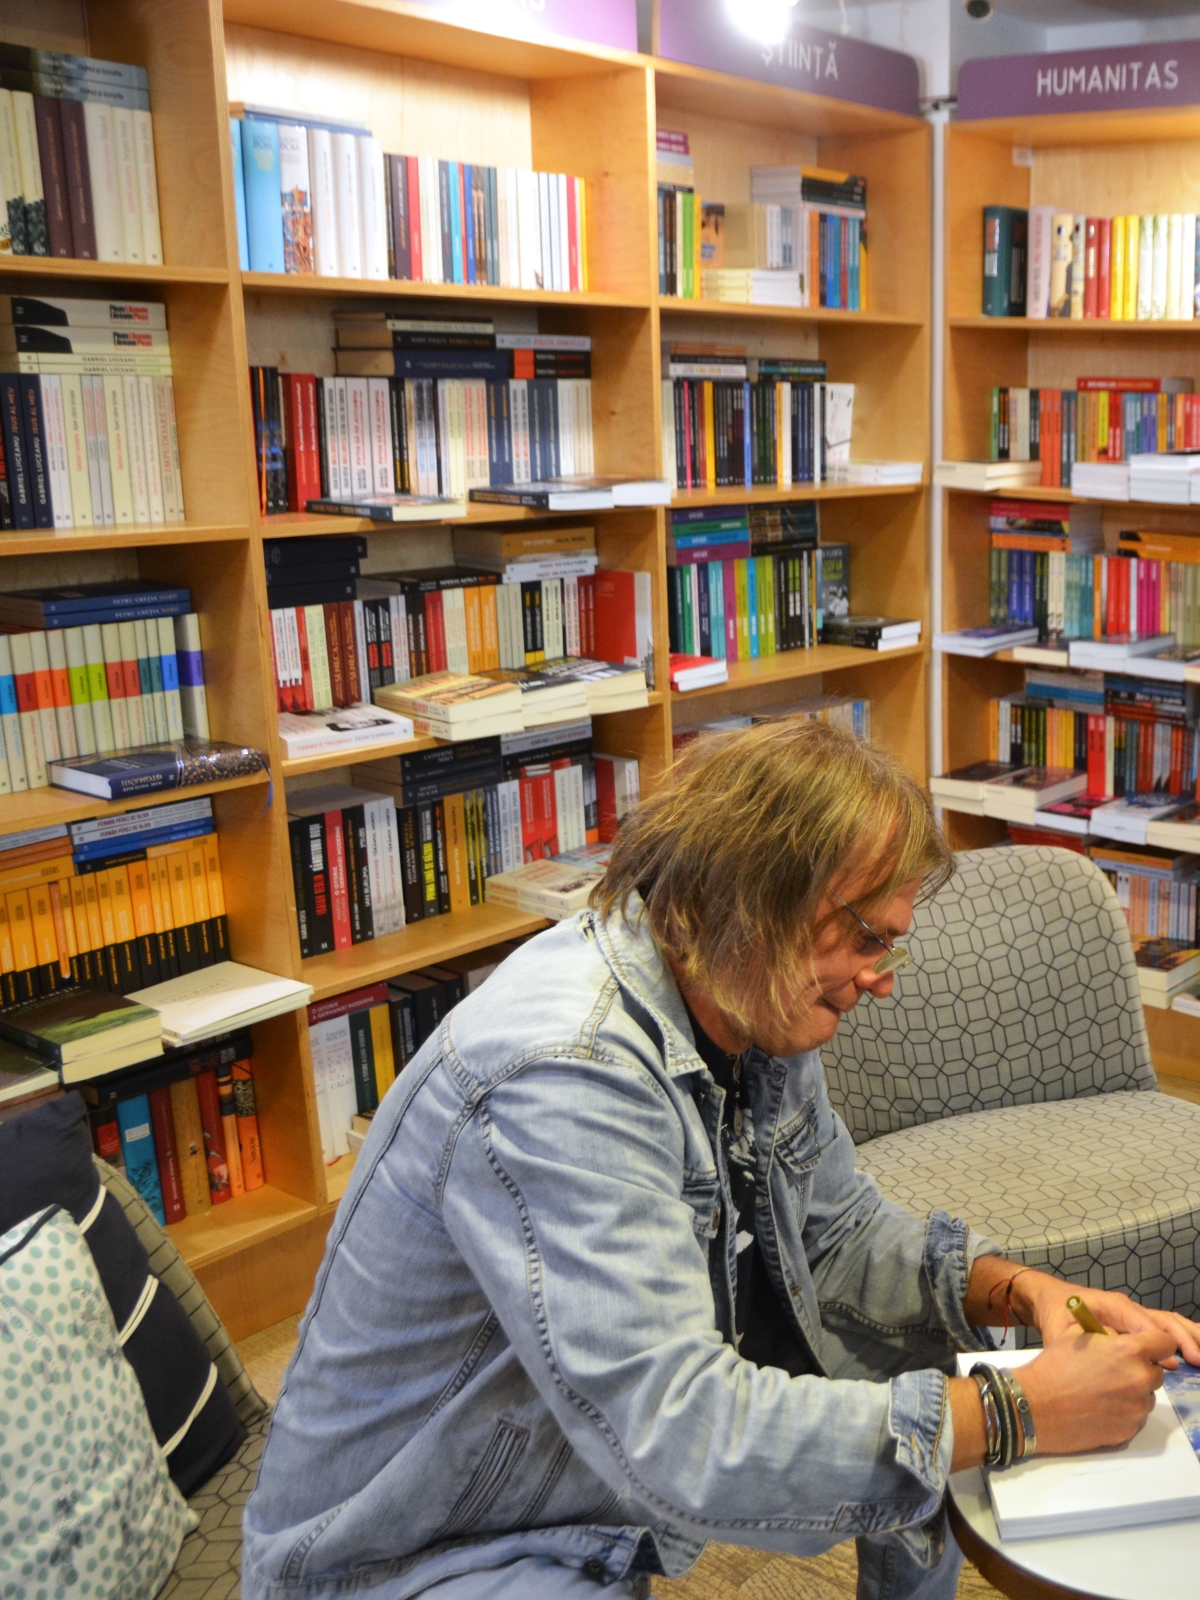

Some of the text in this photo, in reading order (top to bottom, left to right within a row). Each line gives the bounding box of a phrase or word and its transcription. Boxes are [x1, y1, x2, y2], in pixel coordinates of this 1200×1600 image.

[1037, 60, 1179, 97] HUMANITAS
[12, 436, 23, 472] LIICEANU
[33, 436, 43, 472] LIICEANU
[17, 472, 27, 504] GABRIEL
[37, 473, 47, 504] GABRIEL
[317, 1002, 339, 1013] ISTORIE
[318, 1006, 348, 1019] GERMANIEI
[348, 996, 375, 1009] MODERNE
